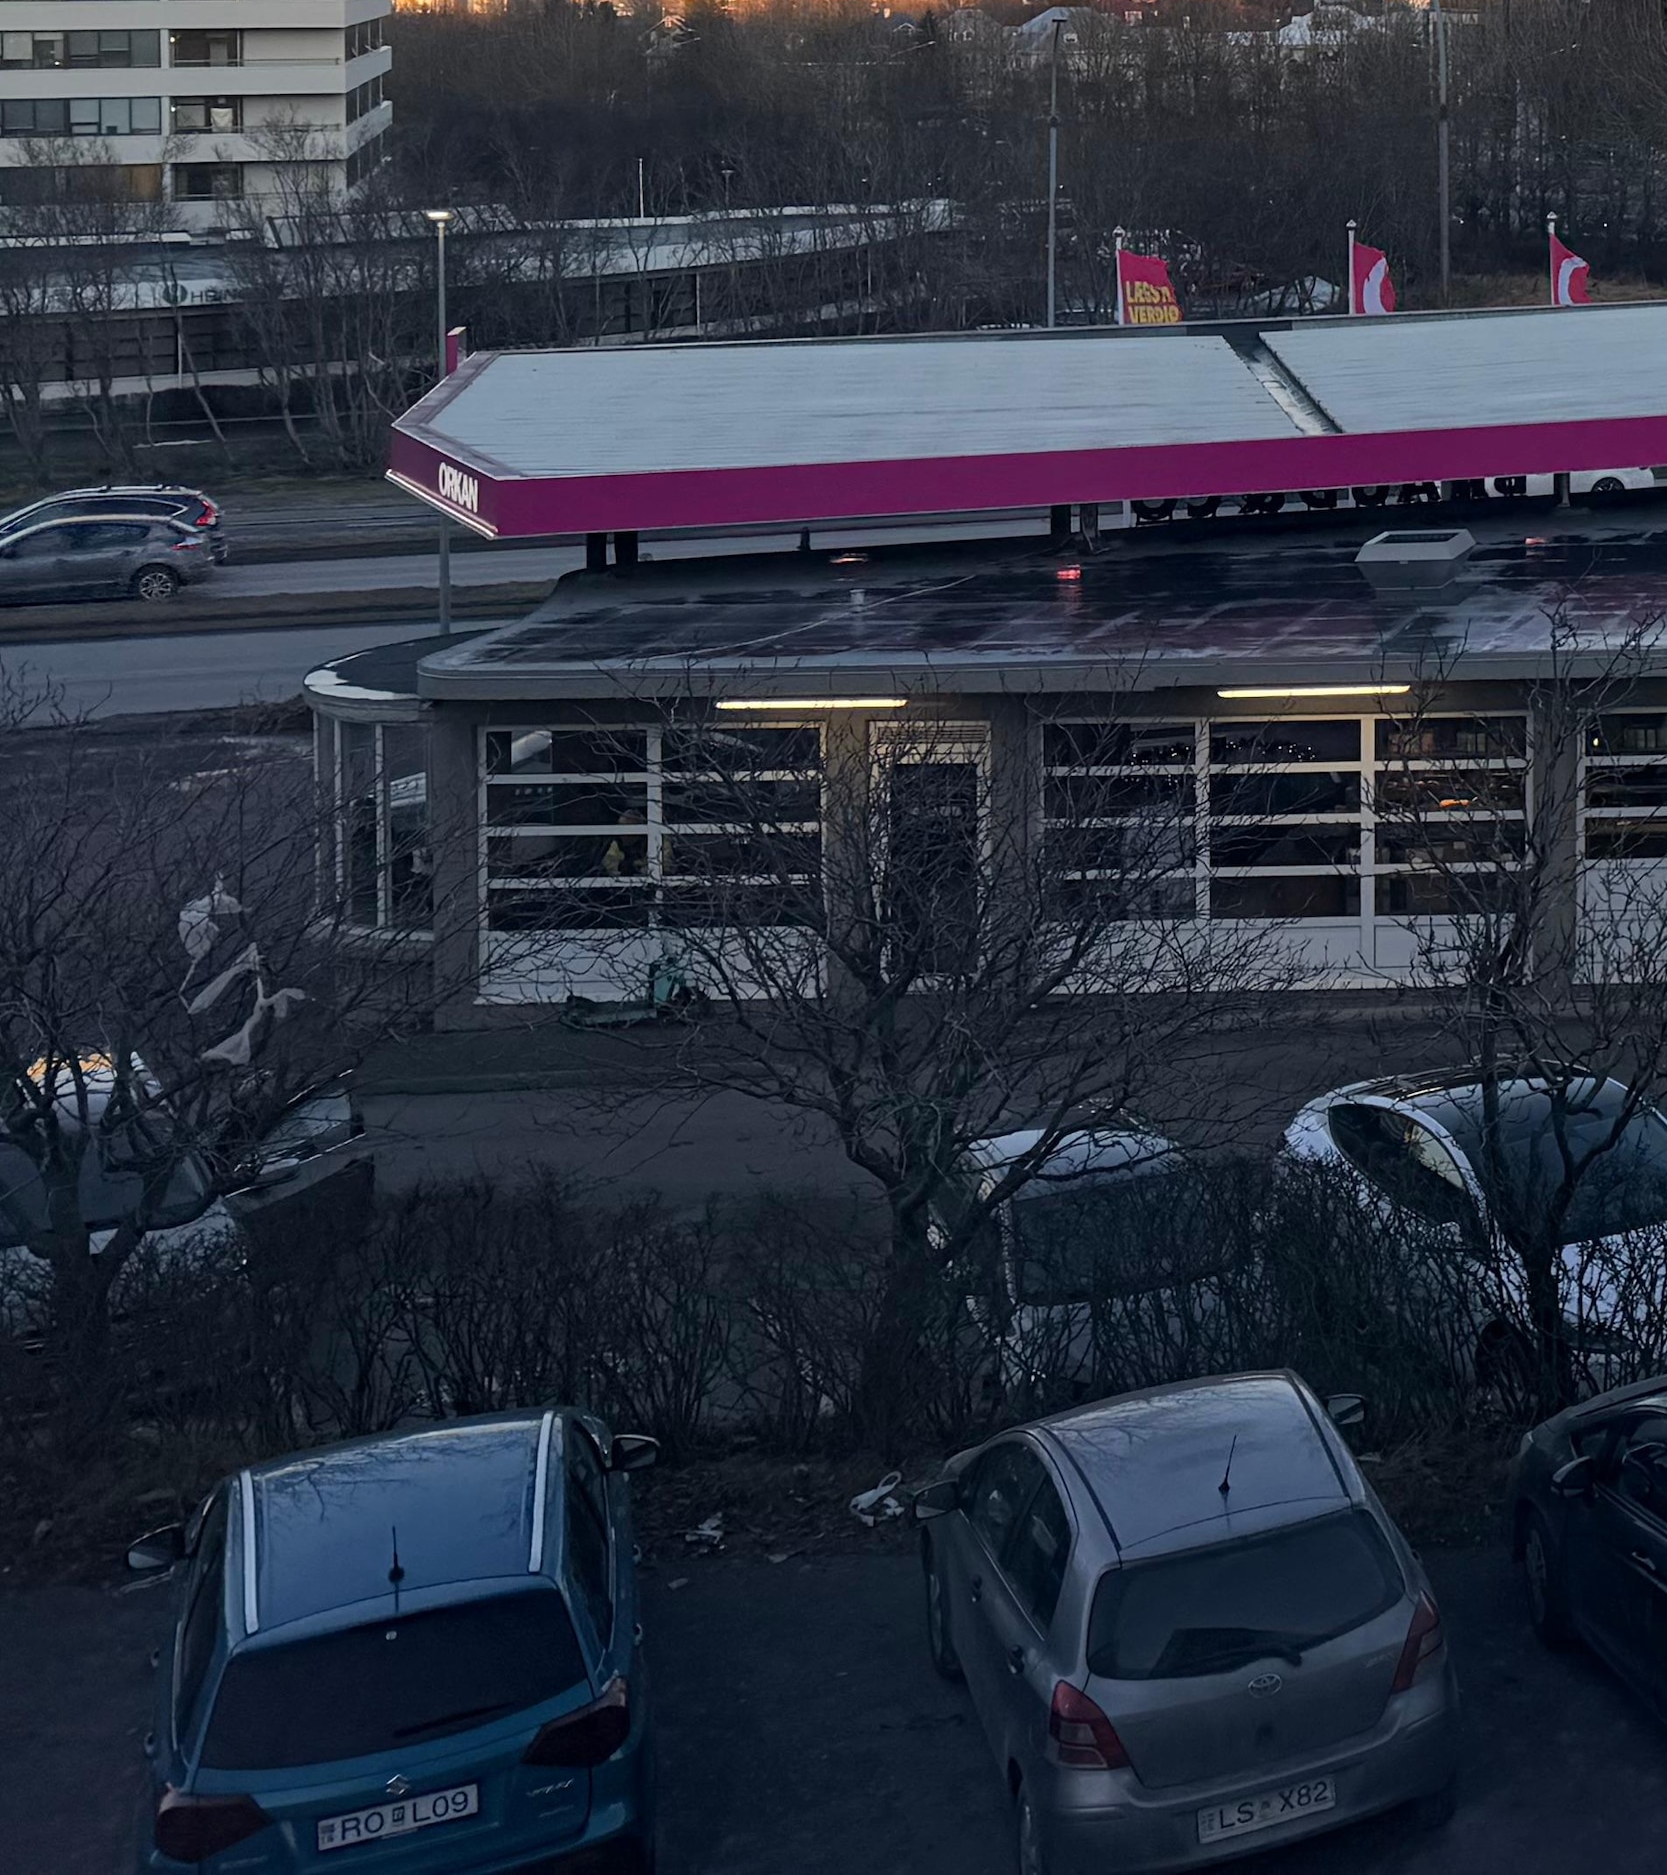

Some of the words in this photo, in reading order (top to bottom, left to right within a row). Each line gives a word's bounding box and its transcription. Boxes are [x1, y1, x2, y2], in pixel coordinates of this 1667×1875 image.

[438, 461, 479, 513] ORKAN
[340, 1812, 384, 1840] RO
[412, 1790, 469, 1823] L09
[1219, 1801, 1255, 1829] LS
[1278, 1781, 1328, 1813] X82
